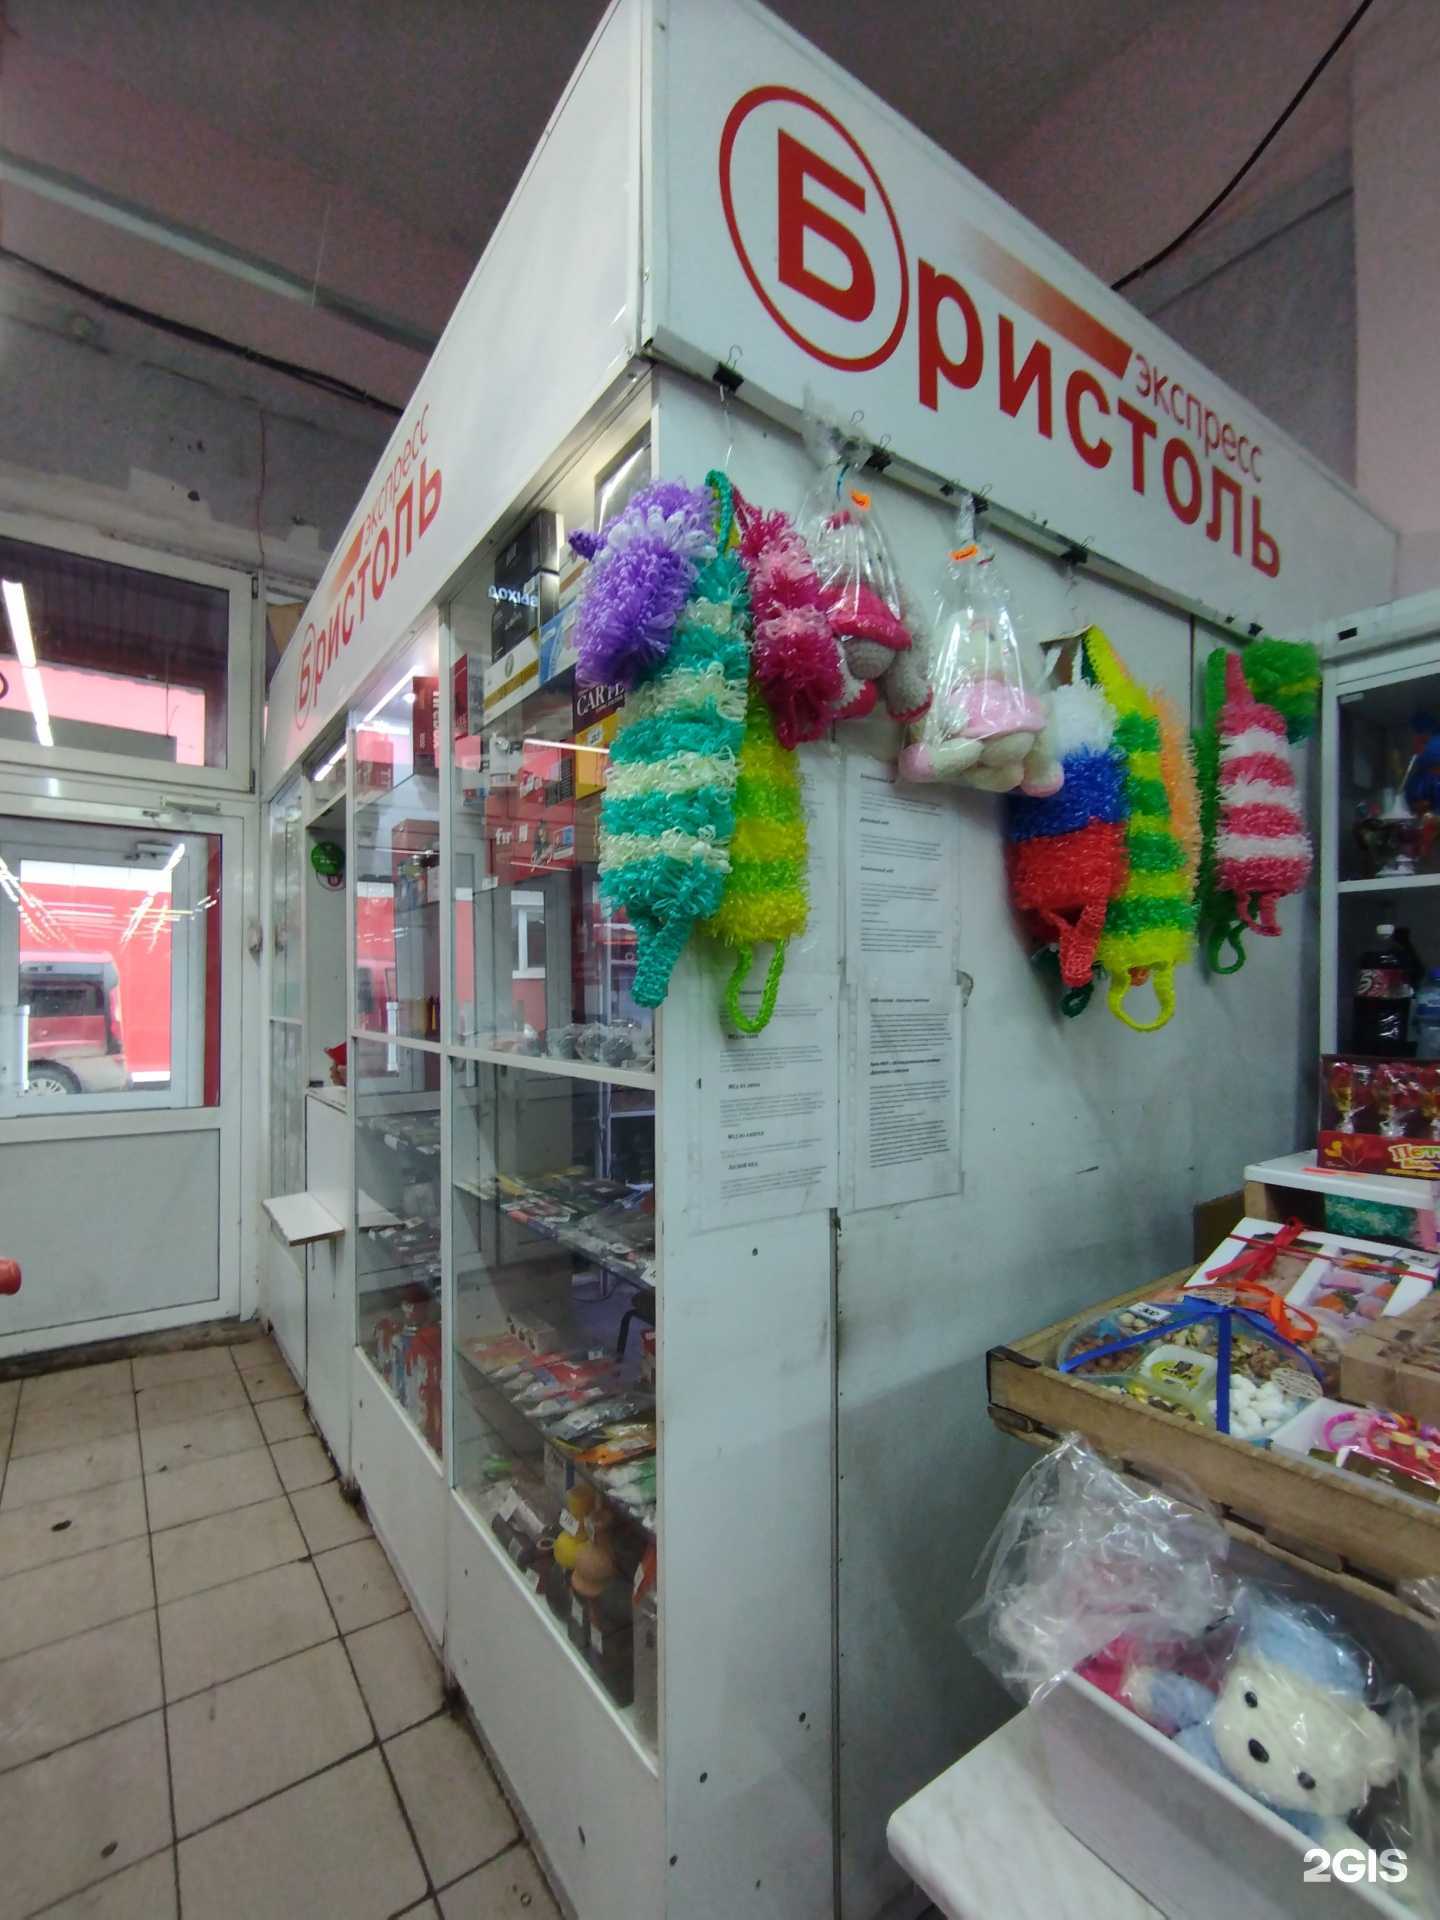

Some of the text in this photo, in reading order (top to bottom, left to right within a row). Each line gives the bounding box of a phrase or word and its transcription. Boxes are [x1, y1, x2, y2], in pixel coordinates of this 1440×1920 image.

[776, 127, 1281, 579] Бристоль
[1134, 353, 1263, 485] экспресс
[298, 455, 443, 711] Бристоль
